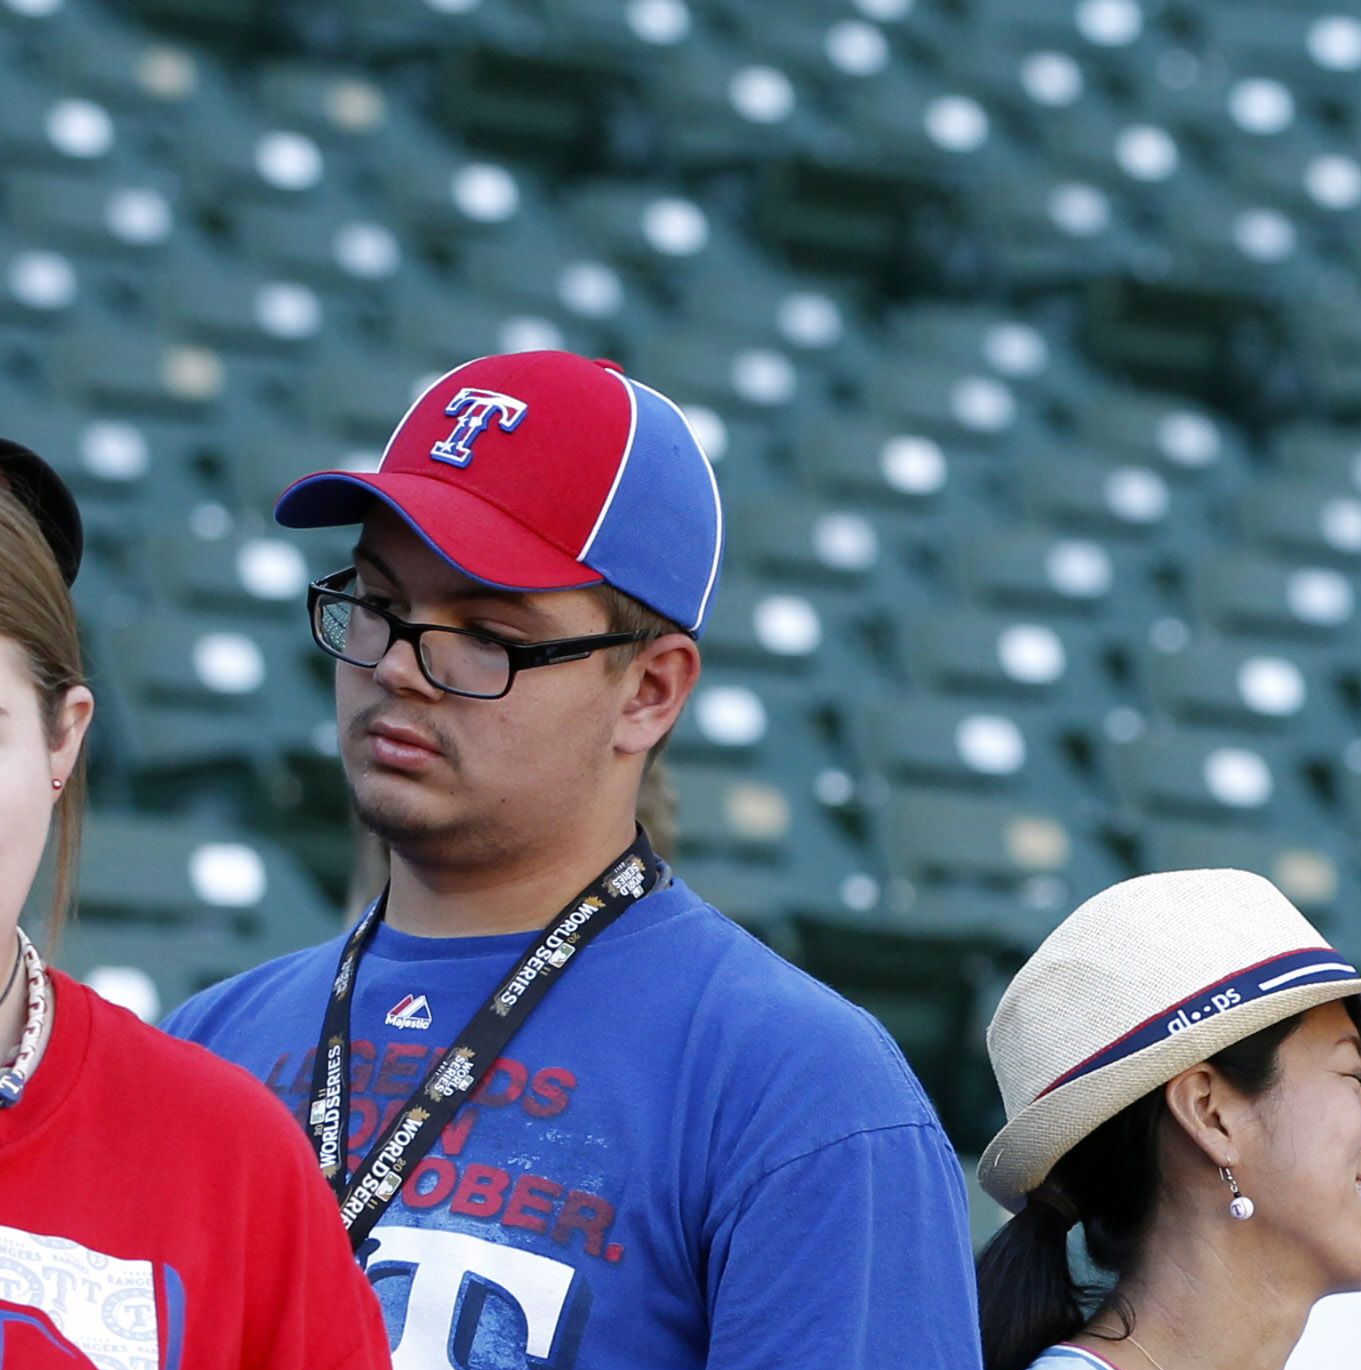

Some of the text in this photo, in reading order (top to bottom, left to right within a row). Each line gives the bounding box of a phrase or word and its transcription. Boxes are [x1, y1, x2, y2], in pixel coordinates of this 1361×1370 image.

[430, 387, 528, 469] T
[385, 1016, 431, 1030] Majestic
[434, 1055, 465, 1092] SERIES
[443, 1062, 475, 1096] WORLD
